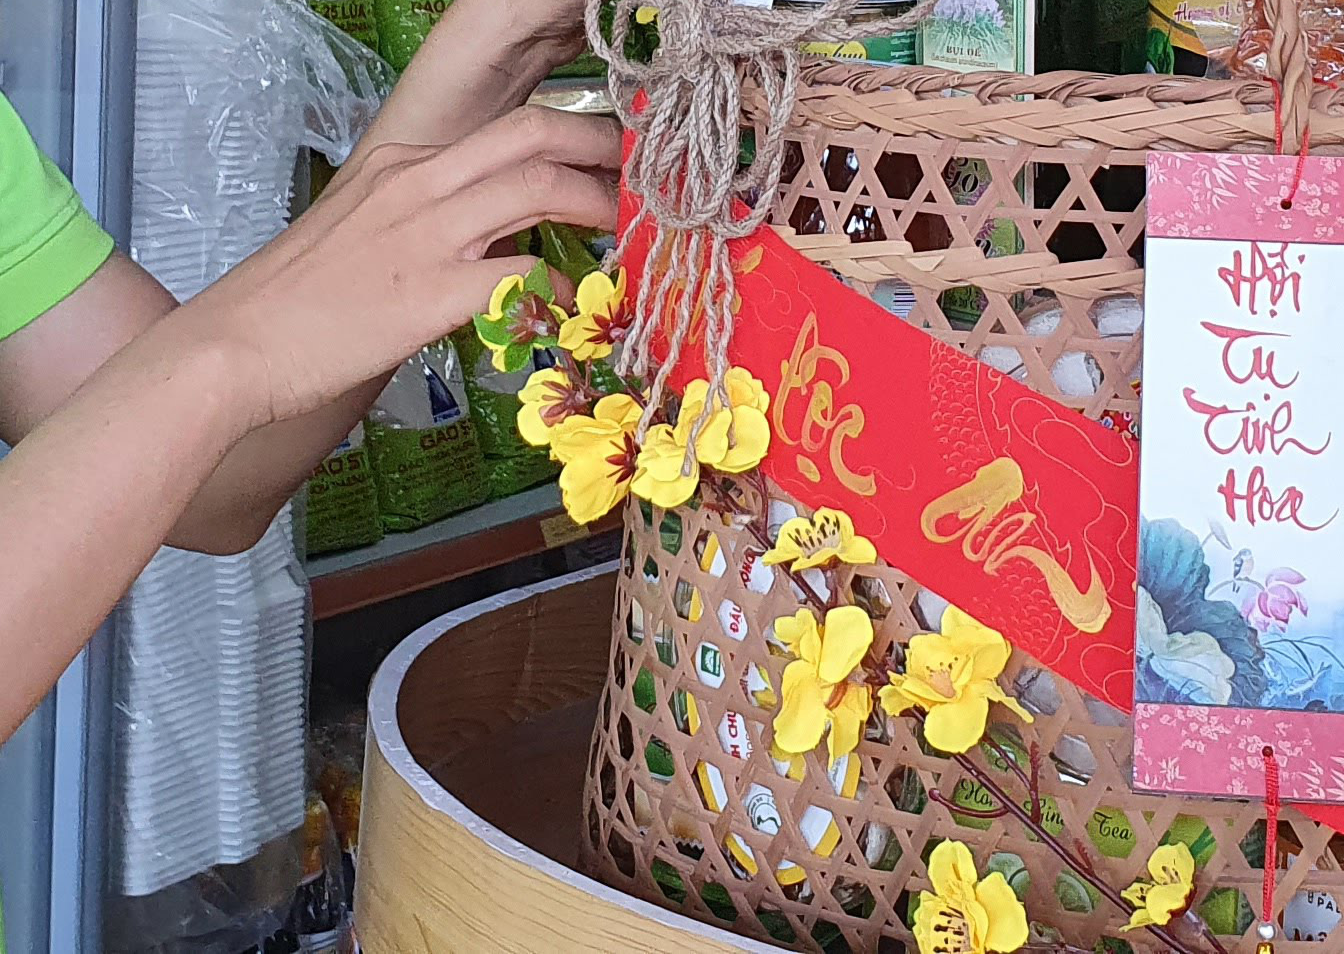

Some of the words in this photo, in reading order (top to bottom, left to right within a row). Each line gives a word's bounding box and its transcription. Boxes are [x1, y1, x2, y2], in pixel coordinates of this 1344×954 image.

[1217, 241, 1305, 319] Hội
[772, 312, 877, 496] Lộc
[1217, 466, 1339, 531] Hoa
[1094, 811, 1131, 840] Tea
